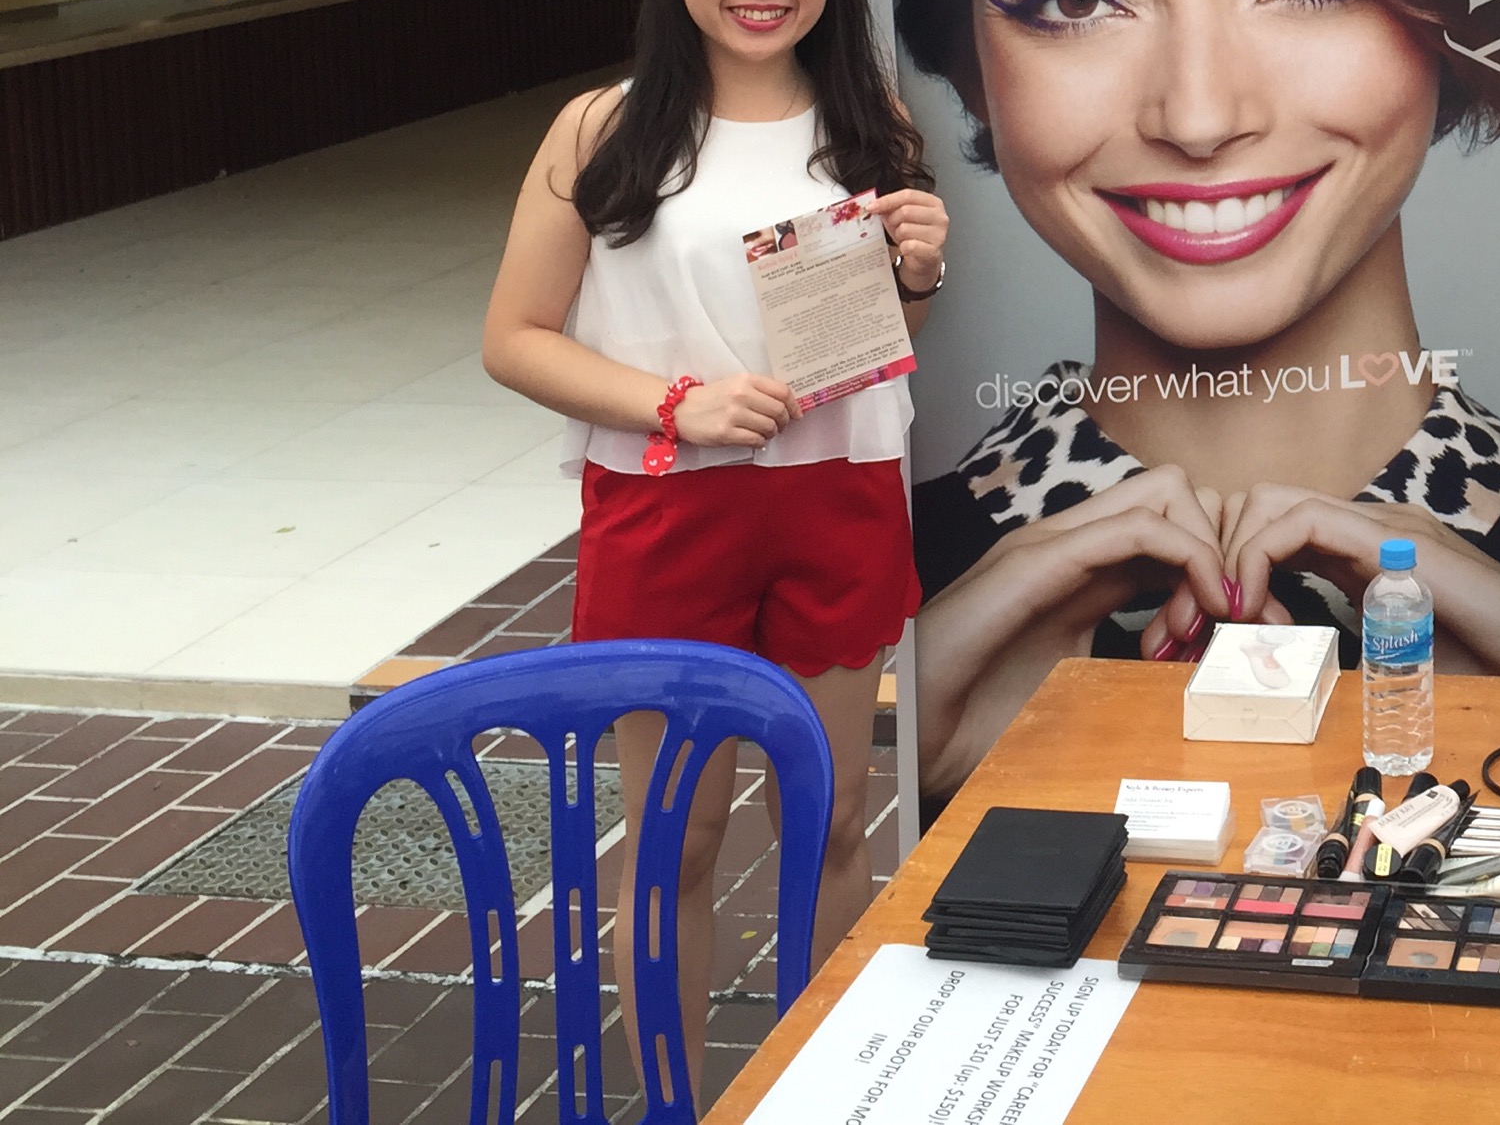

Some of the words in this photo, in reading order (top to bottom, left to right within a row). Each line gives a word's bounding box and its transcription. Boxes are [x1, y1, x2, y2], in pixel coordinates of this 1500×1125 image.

[975, 374, 1146, 409] discover
[1155, 363, 1253, 401] what
[1260, 365, 1330, 404] you
[1373, 631, 1419, 654] Splash
[937, 970, 965, 999] DROP
[1074, 976, 1099, 1001] SIGN
[926, 999, 945, 1014] BY
[1000, 993, 1024, 1016] FOR
[1066, 1002, 1084, 1017] UP
[907, 1014, 933, 1040] OUR
[984, 1016, 1009, 1042] JUST
[1043, 1019, 1075, 1055] TODAY
[854, 1032, 888, 1064] INFO!
[879, 1039, 917, 1080] BOOTH
[969, 1043, 994, 1063] $10
[996, 1030, 1035, 1078] MAKEUP
[953, 1064, 980, 1086] (up:
[1027, 1056, 1052, 1079] FOR
[861, 1080, 888, 1104] FOR
[845, 1105, 871, 1125] MO
